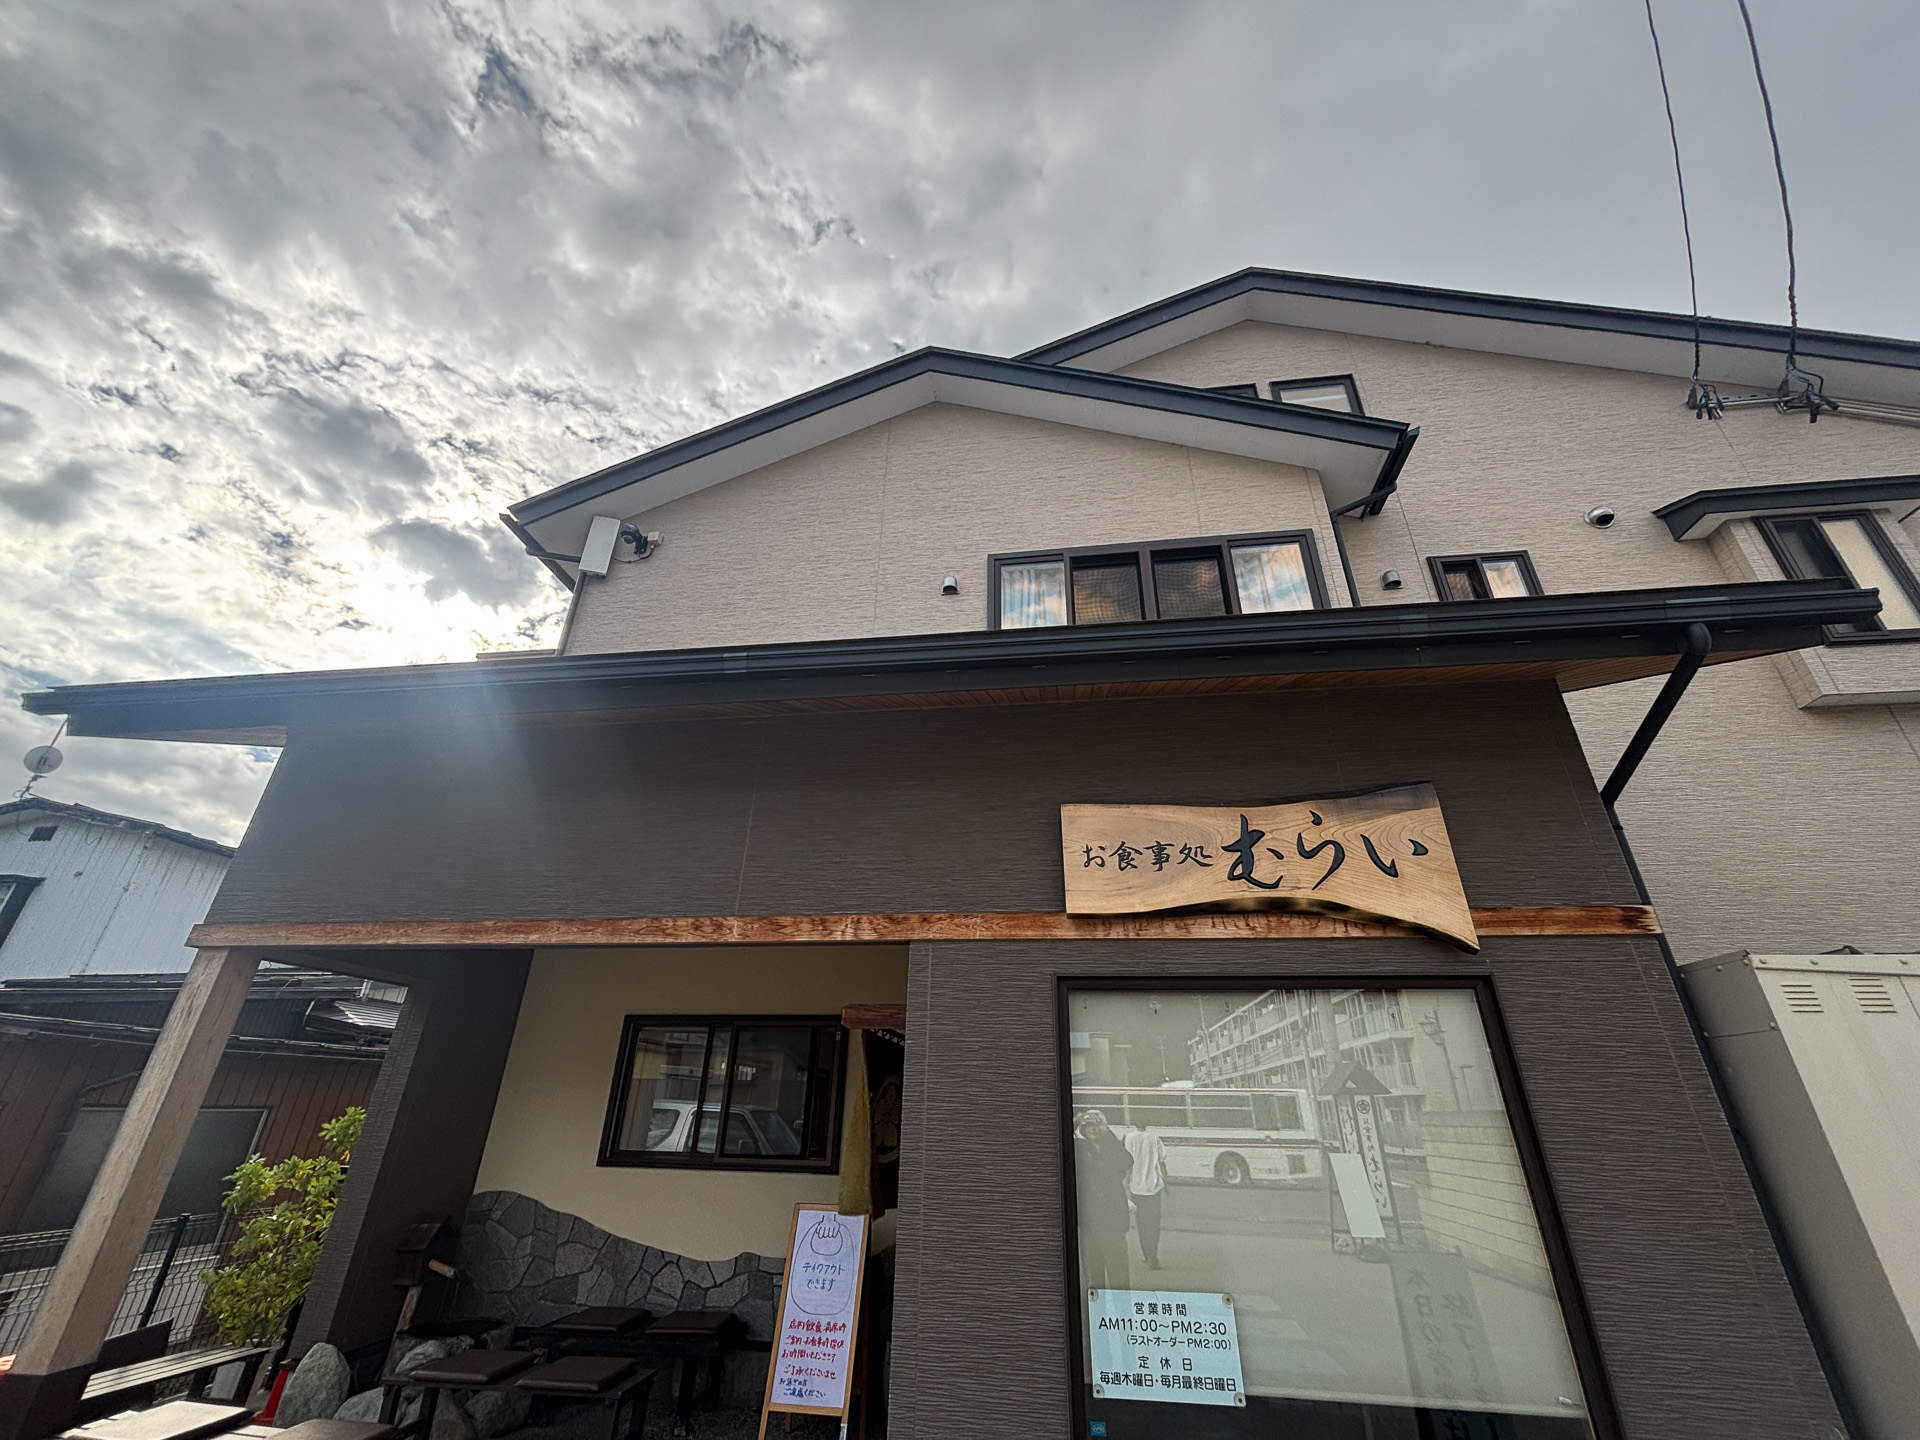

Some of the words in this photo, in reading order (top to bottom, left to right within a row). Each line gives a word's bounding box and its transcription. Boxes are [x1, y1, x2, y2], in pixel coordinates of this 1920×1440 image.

[1082, 840, 1214, 872] お食事処
[1221, 810, 1429, 891] むらい
[802, 1262, 845, 1275] テイクアウト
[806, 1278, 836, 1291] できます
[1133, 1301, 1187, 1317] 営業時間
[1137, 1356, 1193, 1371] 定休日
[1099, 1371, 1237, 1392] 毎週木曜日・毎月最終日曜日
